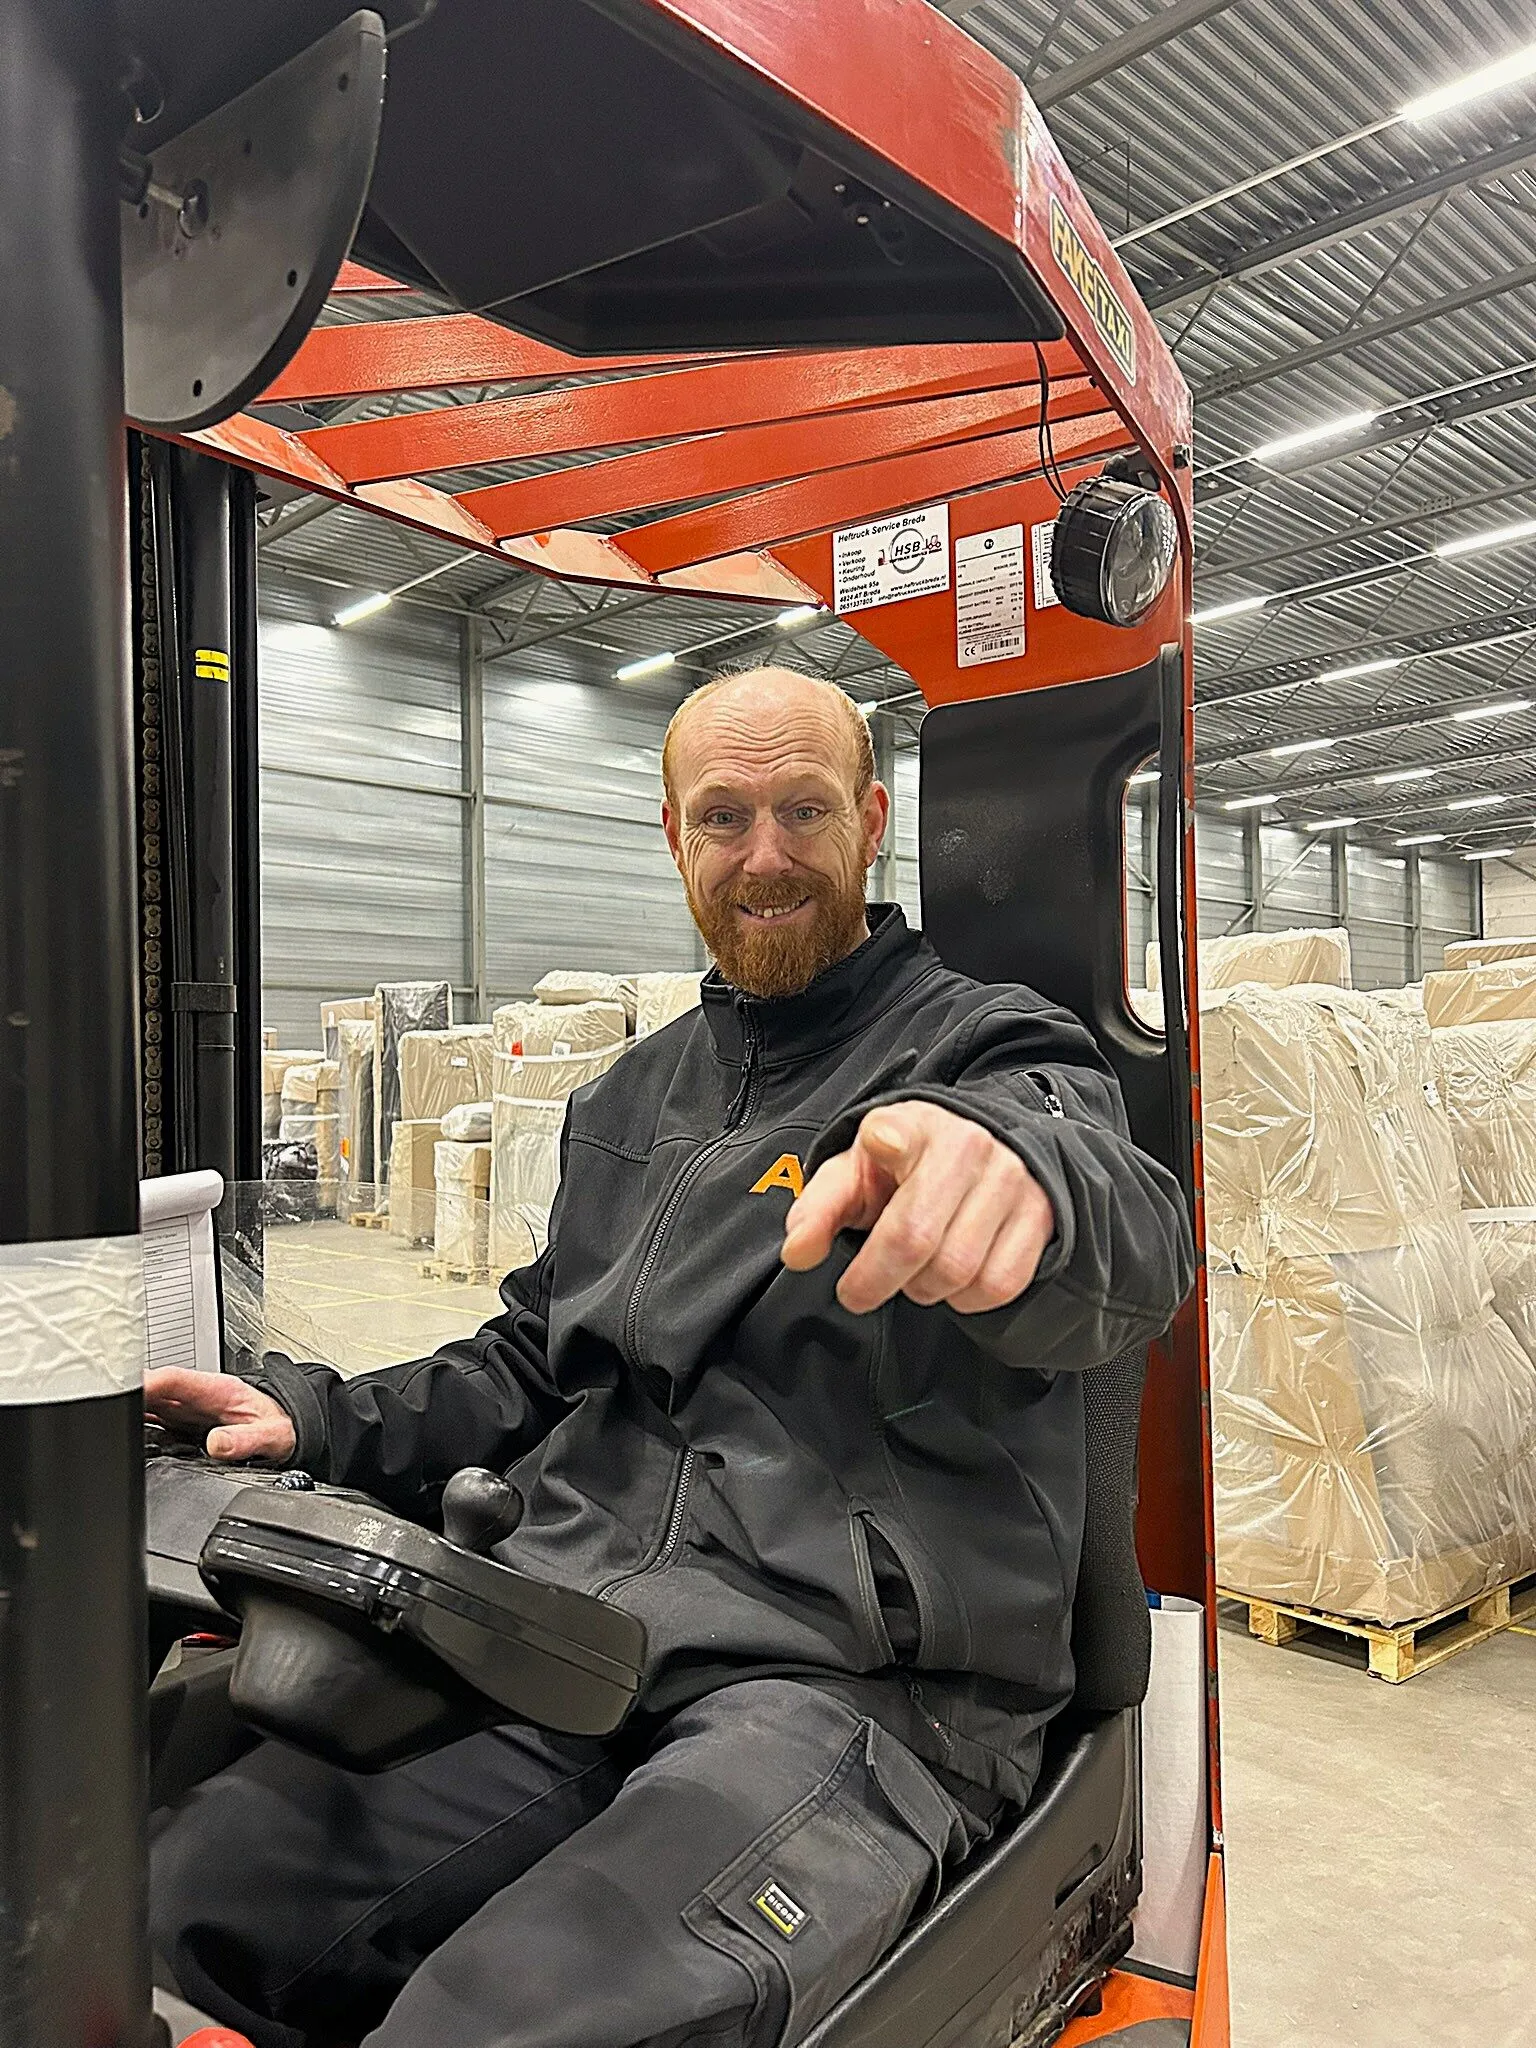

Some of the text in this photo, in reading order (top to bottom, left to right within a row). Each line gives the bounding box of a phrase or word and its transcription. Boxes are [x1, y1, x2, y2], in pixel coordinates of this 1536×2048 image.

[1052, 207, 1131, 362] FAKE TAXI
[838, 515, 926, 543] Heftruck Service Breda
[842, 550, 862, 558] Inkoop
[895, 541, 921, 556] HSB
[842, 557, 866, 566] Verkoop
[842, 566, 866, 575] Keuring
[842, 570, 876, 583] Onderhoud
[863, 589, 881, 598] Breda
